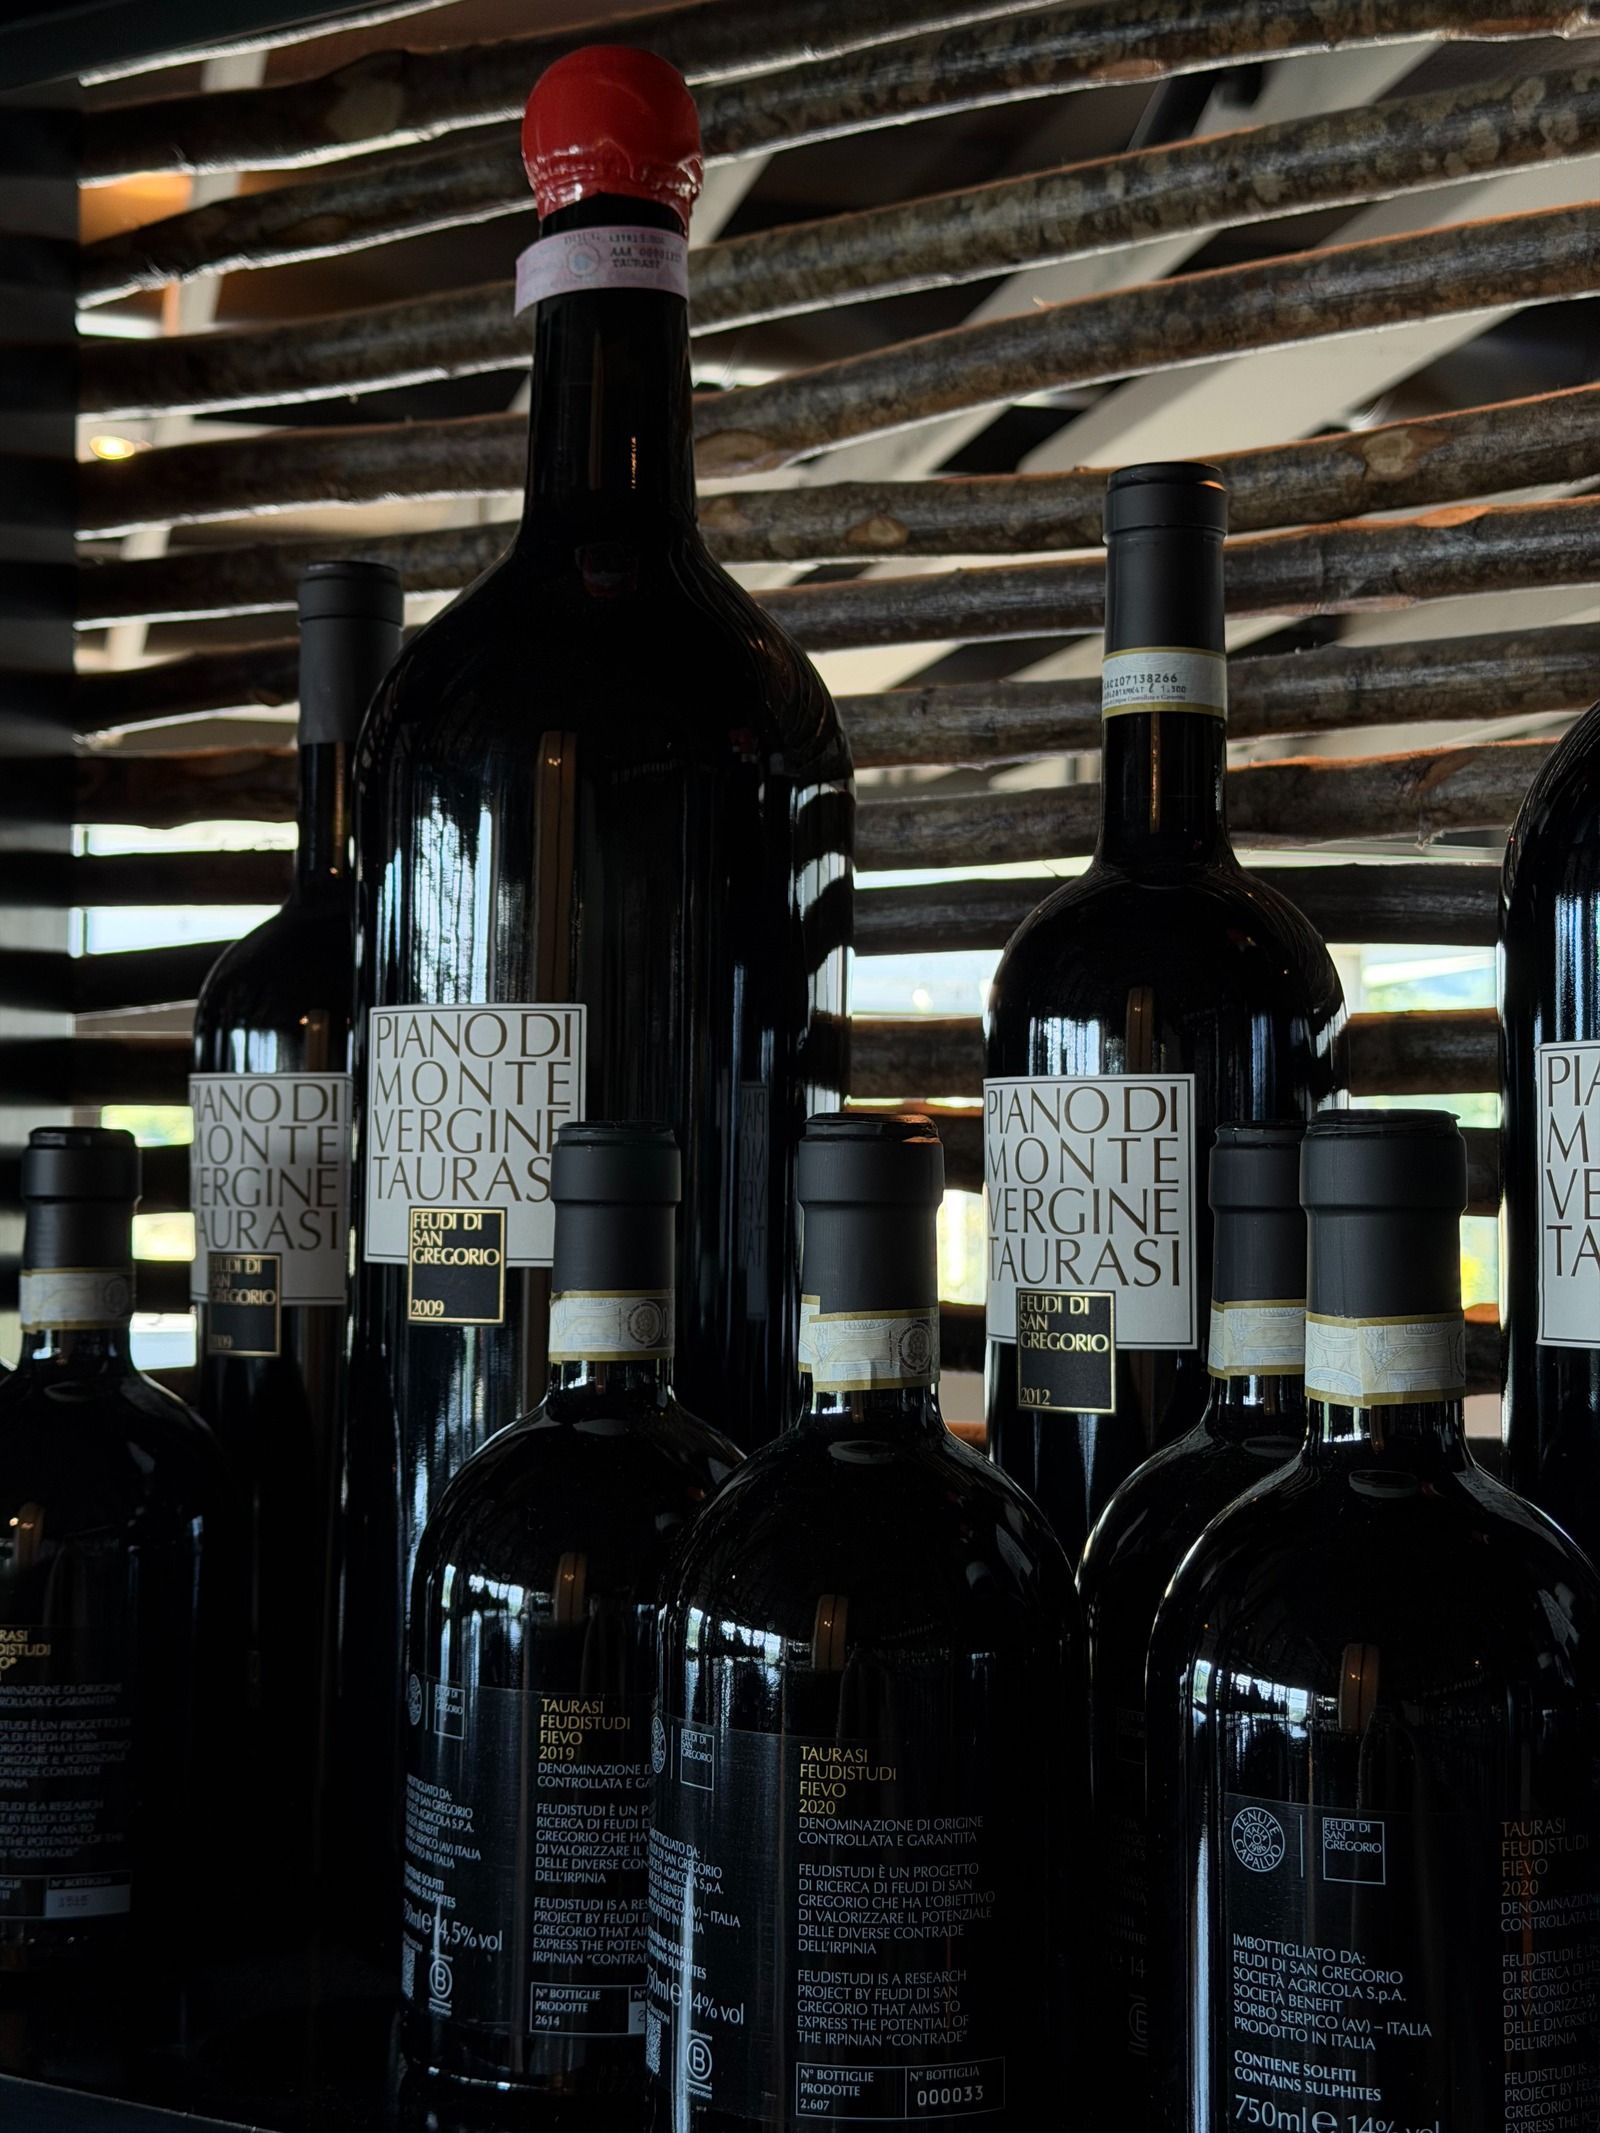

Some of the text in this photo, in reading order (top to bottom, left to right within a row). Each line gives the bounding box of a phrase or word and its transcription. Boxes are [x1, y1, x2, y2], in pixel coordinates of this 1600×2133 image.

[376, 1012, 572, 1059] PIANO DI
[373, 1060, 572, 1107] MONTE
[293, 1083, 338, 1123] DI
[986, 1086, 1179, 1135] PIANO DI
[986, 1137, 1180, 1185] MONTE
[199, 1167, 338, 1208] ERGINE
[372, 1156, 552, 1202] TAURAS
[986, 1187, 1180, 1236] VERGINE
[413, 1212, 482, 1230] FEUDI DI
[412, 1230, 443, 1247] SAN
[412, 1247, 500, 1265] GREGORIO
[987, 1236, 1180, 1288] TAURASI
[411, 1300, 444, 1316] 2009
[1020, 1295, 1089, 1315] FEUDI DI
[1019, 1313, 1048, 1331] SAN
[1019, 1330, 1109, 1352] GREGORIO
[1020, 1390, 1051, 1406] 2012
[541, 1699, 604, 1714] TAURASI
[539, 1714, 631, 1730] FEUDISTUDI
[539, 1730, 583, 1746] FIEVO
[538, 1745, 575, 1761] 2019
[799, 1745, 869, 1764] TAURASI
[537, 1762, 642, 1776] DENOMINAZIONE
[799, 1763, 898, 1782] FEUDISTUDI
[537, 1776, 623, 1790] CONTROLLATA
[799, 1781, 847, 1799] FIEVO
[536, 1802, 607, 1817] FEUDISTUDI
[799, 1799, 837, 1816] 2020
[535, 1816, 639, 1830] RICERCA FEUDI
[799, 1815, 984, 1833] DENOMINAZIONE DI ORIGINE
[1234, 1809, 1280, 1837] TENUTE
[1324, 1820, 1371, 1833] FEUDI DI
[1500, 1817, 1566, 1839] TAURASI
[535, 1830, 599, 1843] GREGORIO
[798, 1831, 977, 1848] CONTROLLATA GARANTITA
[1246, 1826, 1268, 1842] ITALIA
[1324, 1830, 1346, 1841] SAN
[686, 1844, 701, 1859] DA:
[1234, 1838, 1282, 1870] CAPALDO
[1324, 1839, 1382, 1854] GREGORIO
[1501, 1833, 1590, 1858] FEUDISTUDI
[535, 1856, 619, 1870] DELLE DIVERSE
[677, 1855, 723, 1879] GREGORIO
[799, 1862, 980, 1879] FEUDISTUDI UN PROGETTO
[1502, 1858, 1549, 1878] FIEVO
[815, 1879, 973, 1894] RICERCA FEUDI SAN
[1502, 1879, 1539, 1897] 2020
[534, 1896, 604, 1911] FEUDISTUDI
[798, 1894, 899, 1909] GREGORIO CHE
[533, 1910, 640, 1925] PROJECT FEUDI
[710, 1910, 741, 1929] ITALIA
[815, 1906, 993, 1924] VALORIZZARE POTENZIALE
[533, 1924, 596, 1938] GREGORIO
[798, 1923, 966, 1940] DELLE DIVERSE CONTRADE
[477, 1929, 504, 1952] vol
[532, 1937, 578, 1951] EXPRESS
[1232, 1932, 1367, 1966] IMBOTTIGLIATO DA:
[532, 1951, 584, 1965] IRPINIAN
[1233, 1949, 1404, 1985] FEUDI SAN GREGORIO
[1502, 1948, 1575, 1968] FEUDISTUDI
[798, 1968, 968, 1985] FEUDISTUDI RESEARCH
[1520, 1967, 1570, 1984] RICERCA
[798, 1984, 958, 2001] PROJECT FEUDI SAN
[1232, 1966, 1407, 2004] SOCIETÀ AGRICOLA S.p.A.
[1502, 1981, 1570, 2002] GREGORIO
[550, 1988, 601, 2001] BOTTIGLIE
[1233, 1983, 1344, 2014] SOCIETÀ BENEFIT
[535, 2000, 590, 2013] PRODOTTE
[720, 2001, 745, 2026] vol
[797, 1999, 941, 2016] GREGORIO THAT AIMS
[797, 2015, 950, 2031] EXPRESS THE POTENTIAL
[1233, 2000, 1432, 2038] SORBO SERPICO (AV) ITALIA
[1503, 2018, 1541, 2035] DELLE
[797, 2030, 883, 2047] THE IRPINIAN
[1234, 2016, 1376, 2051] PRODOTTO ITALIA
[925, 2065, 980, 2081] BOTTIGLIA
[1233, 2049, 1356, 2083] CONTIENE SOLFITI
[816, 2069, 875, 2083] BOTTIGLIE
[1233, 2065, 1382, 2102] CONTAINS SULPHITES
[1504, 2065, 1576, 2086] FEUDISTUDI
[799, 2082, 861, 2097] PRODOTTE
[916, 2084, 984, 2106] 000033
[1504, 2083, 1558, 2103] PROJECT
[799, 2098, 831, 2111] 2.607
[1234, 2093, 1307, 2133] 750ml
[1505, 2098, 1572, 2119] GREGORIO
